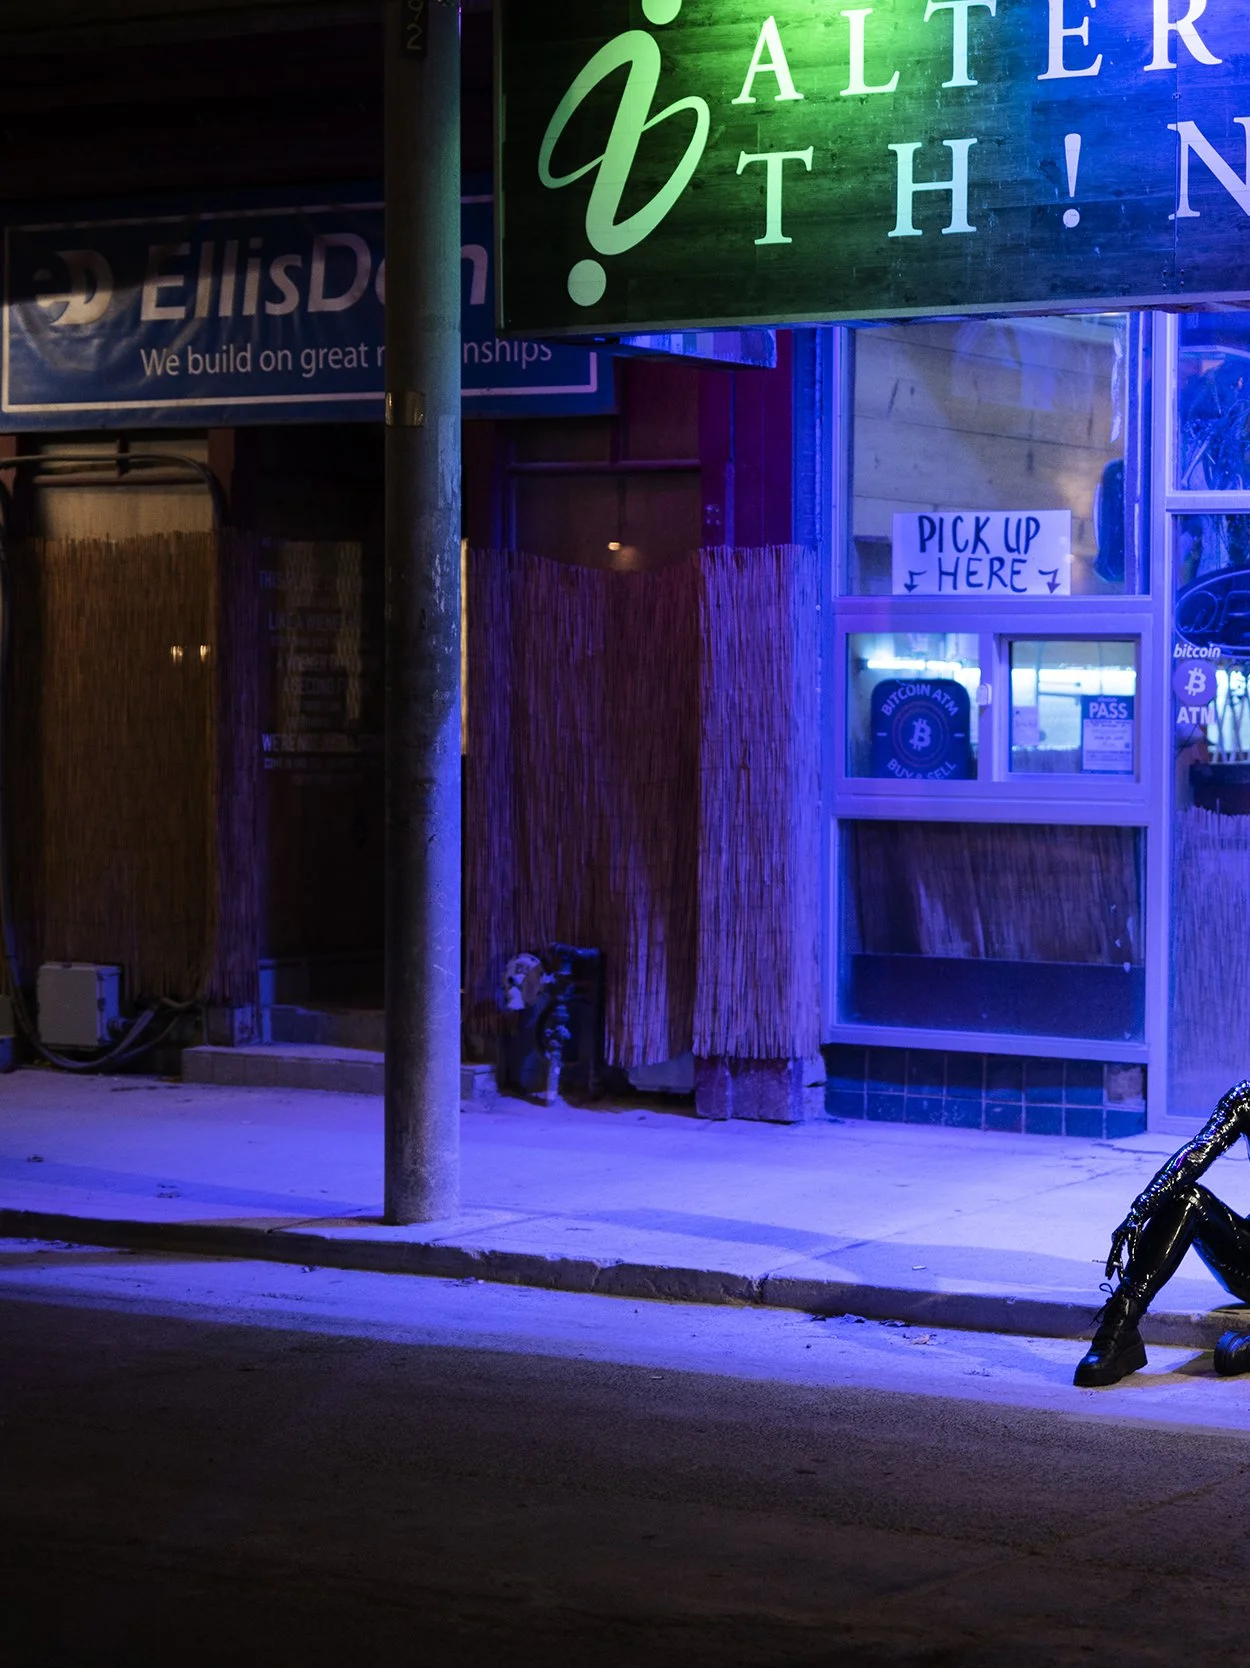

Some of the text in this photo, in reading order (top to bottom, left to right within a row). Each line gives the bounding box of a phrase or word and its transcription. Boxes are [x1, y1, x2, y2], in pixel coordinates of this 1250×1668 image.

[140, 231, 489, 322] EllisDn
[140, 347, 181, 377] We
[187, 343, 252, 373] build
[259, 348, 293, 371] on
[300, 341, 369, 378] great
[918, 515, 1041, 555] PICK UP
[938, 556, 1028, 593] HERE
[1173, 643, 1222, 658] bitcoin
[881, 683, 960, 717] BITCOIN ATM
[1088, 702, 1129, 719] PASS
[1176, 706, 1217, 725] ATM
